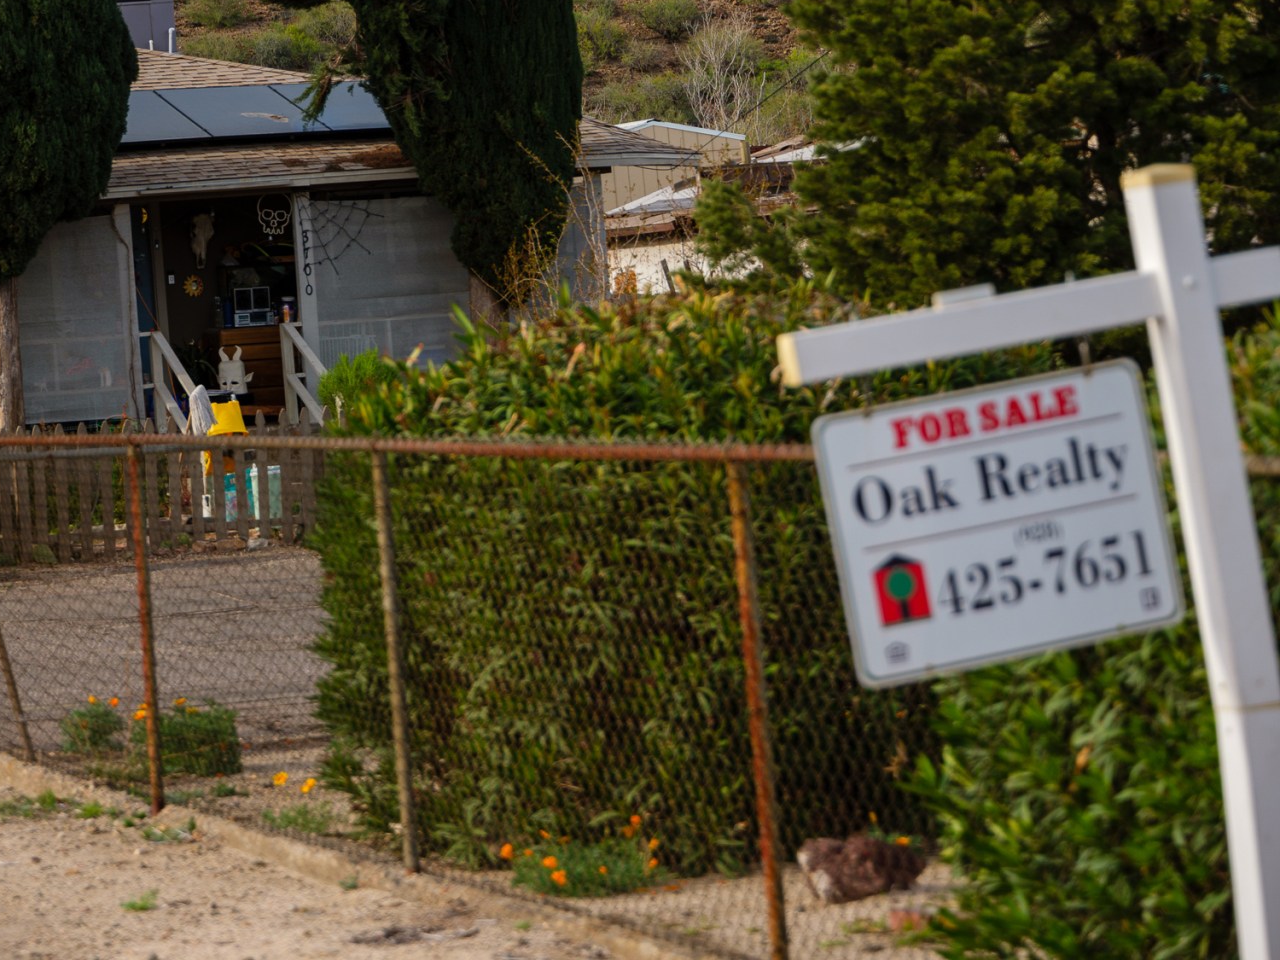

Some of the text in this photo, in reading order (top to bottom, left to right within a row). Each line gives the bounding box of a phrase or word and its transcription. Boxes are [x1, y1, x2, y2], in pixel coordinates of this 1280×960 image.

[891, 386, 1079, 448] FOR SALE
[853, 435, 1129, 525] Oak Realty
[938, 530, 1154, 616] 425-7651
